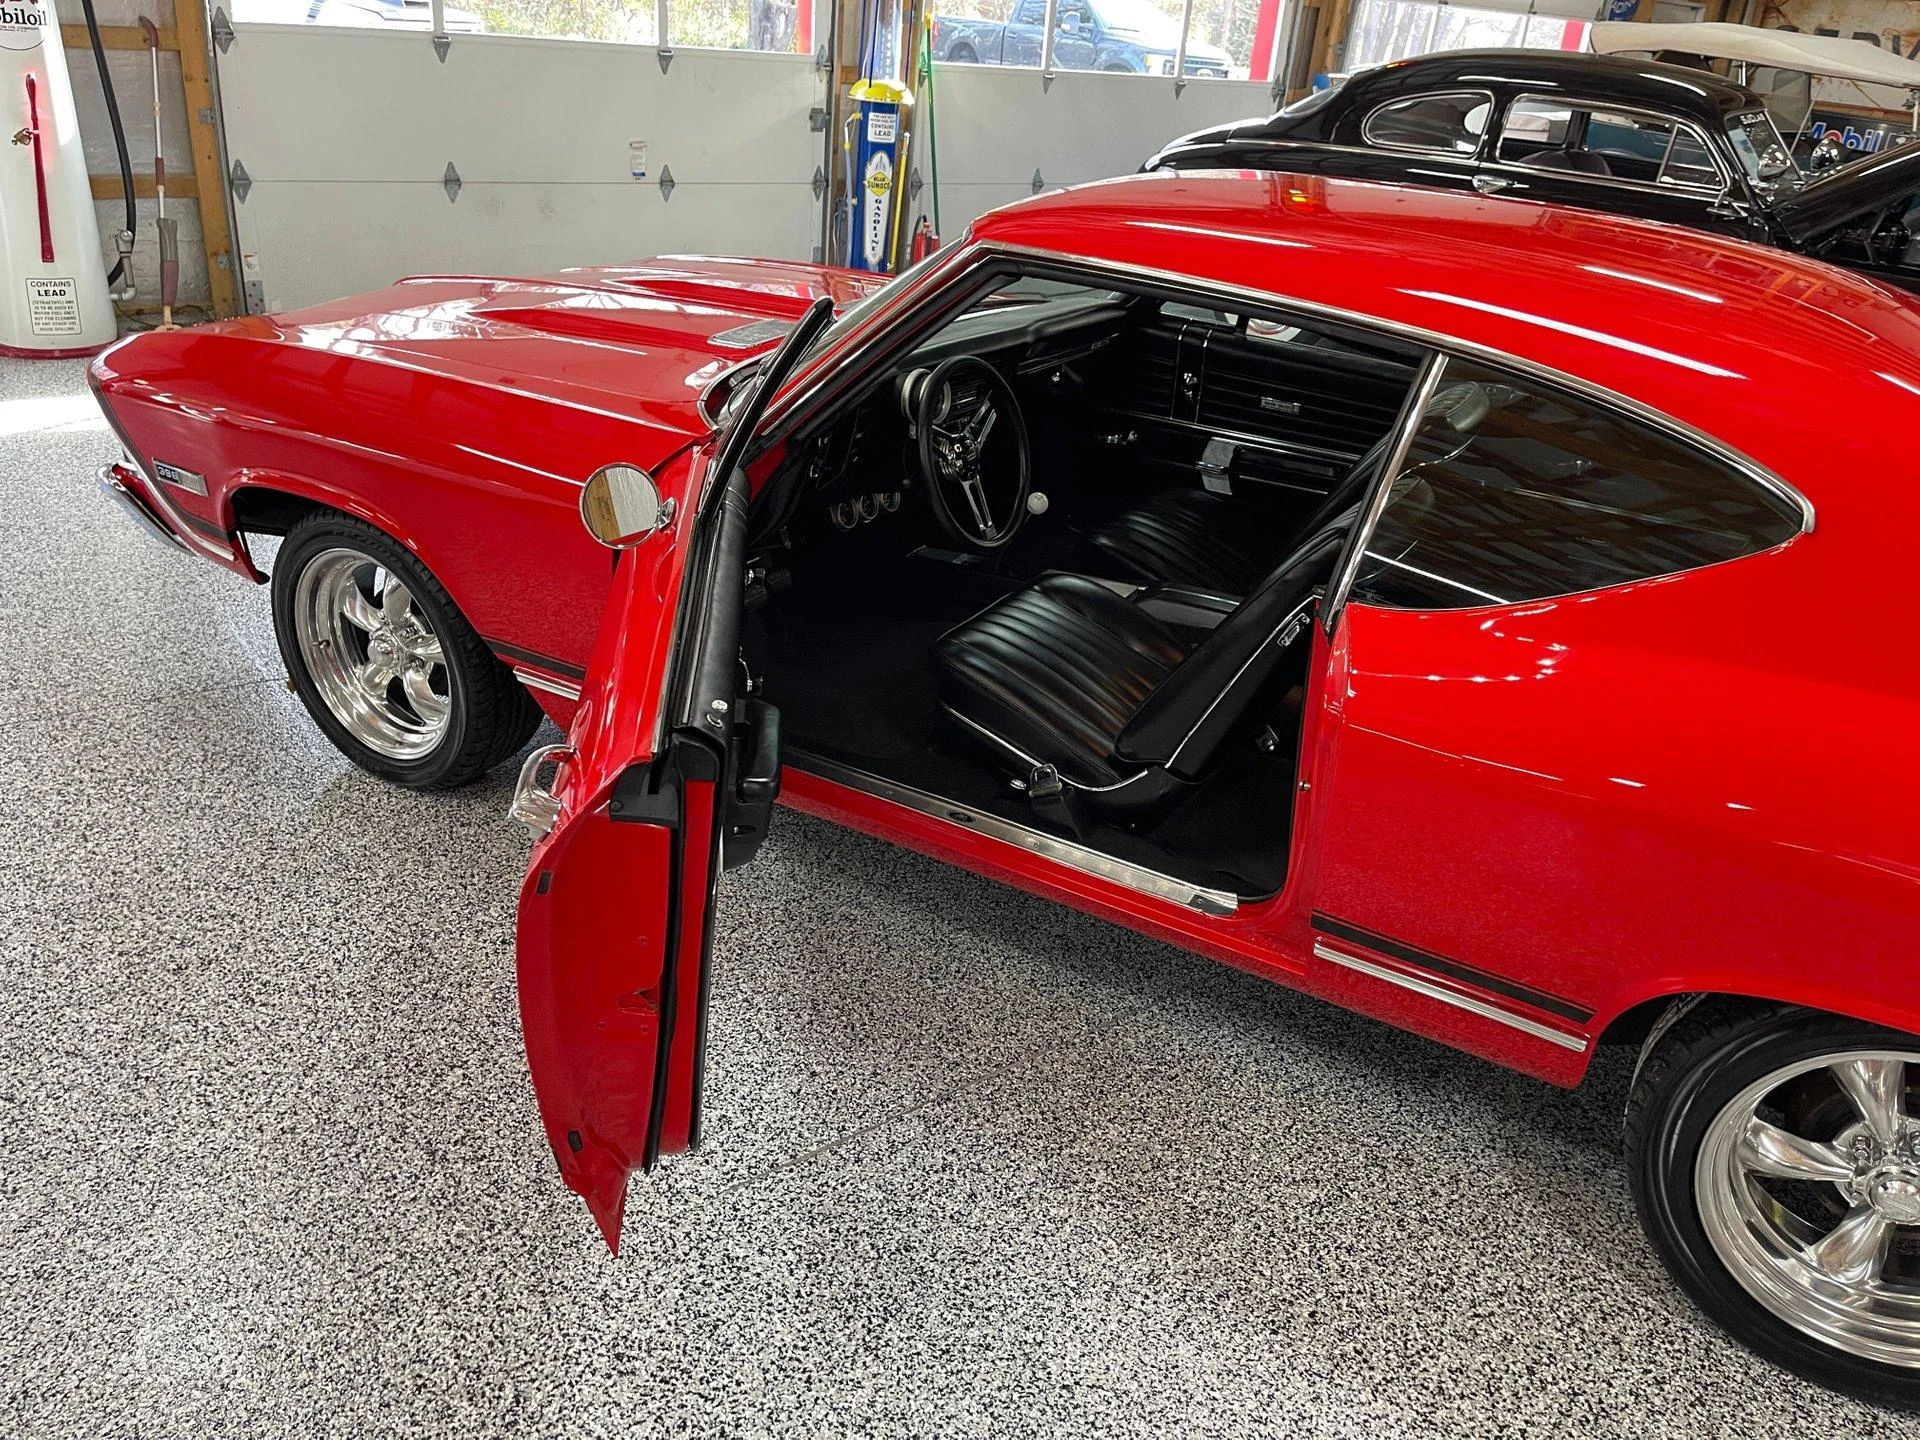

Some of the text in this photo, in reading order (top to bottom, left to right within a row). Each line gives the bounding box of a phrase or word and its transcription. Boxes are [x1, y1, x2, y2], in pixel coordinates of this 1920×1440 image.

[0, 7, 47, 25] biloil
[867, 180, 890, 189] SUNOCO
[871, 198, 882, 252] GASOLINE
[30, 280, 71, 288] CONTAINS
[37, 289, 66, 297] LEAD
